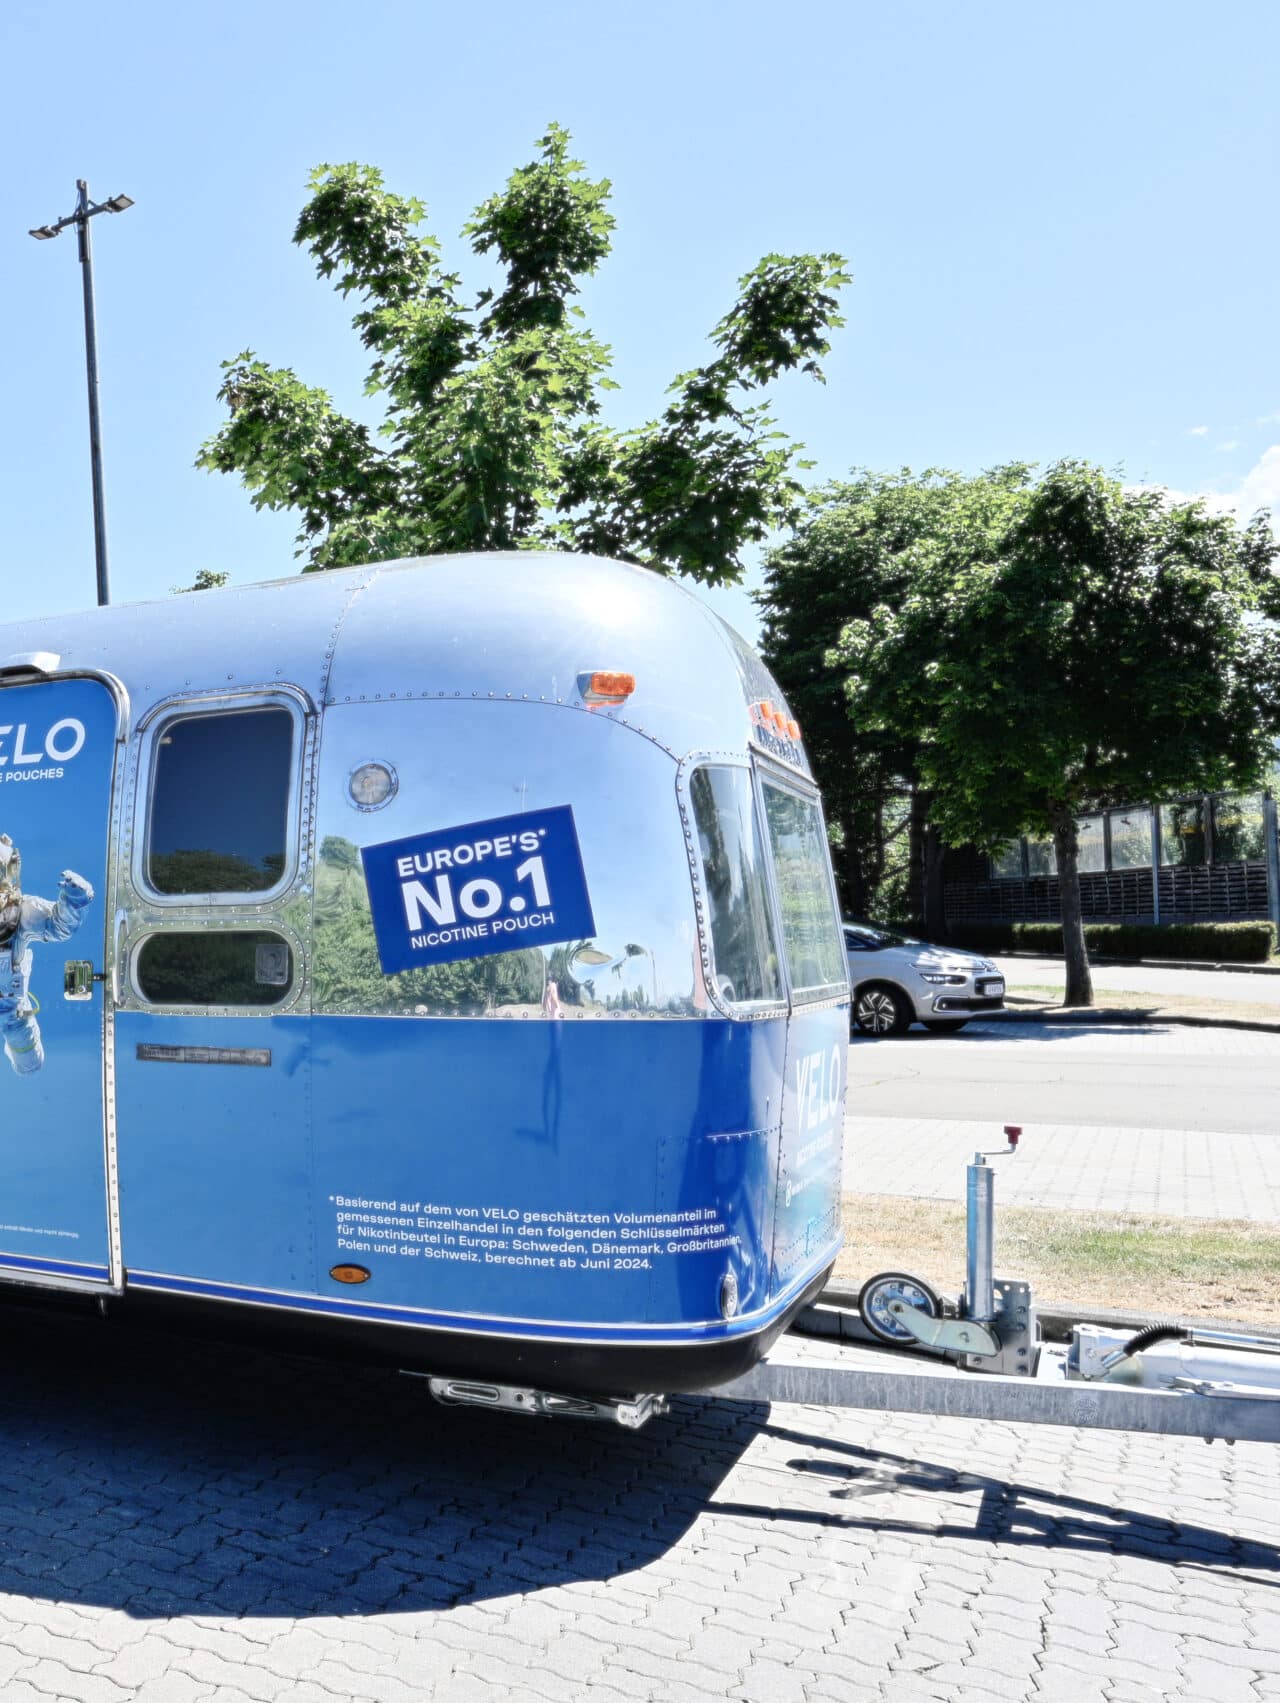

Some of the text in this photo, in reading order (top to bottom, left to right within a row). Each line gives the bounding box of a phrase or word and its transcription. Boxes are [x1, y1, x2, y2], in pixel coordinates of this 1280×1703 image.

[6, 767, 64, 781] POUCHES
[401, 856, 551, 931] No.1
[410, 912, 555, 949] NICOTINE POUCH
[796, 1043, 841, 1136] VELO
[336, 1212, 725, 1240] gemessenen Einzelhandel in den folgenden Schlüsselmärkten
[400, 1202, 421, 1213] auf
[424, 1203, 452, 1215] dem
[455, 1208, 479, 1217] von
[482, 1207, 519, 1220] VELO
[523, 1211, 610, 1223] geschätzten
[614, 1209, 702, 1224] Volumenanteil
[704, 1208, 717, 1220] im
[336, 1224, 355, 1236] für
[357, 1226, 441, 1244] Nikotinbeutel
[443, 1233, 456, 1245] in
[459, 1235, 509, 1250] Europa:
[512, 1239, 588, 1254] Schweden,
[592, 1242, 664, 1255] Dänemark,
[337, 1238, 653, 1270] Polen und der Schweiz, berechnet ab Juni 2024.
